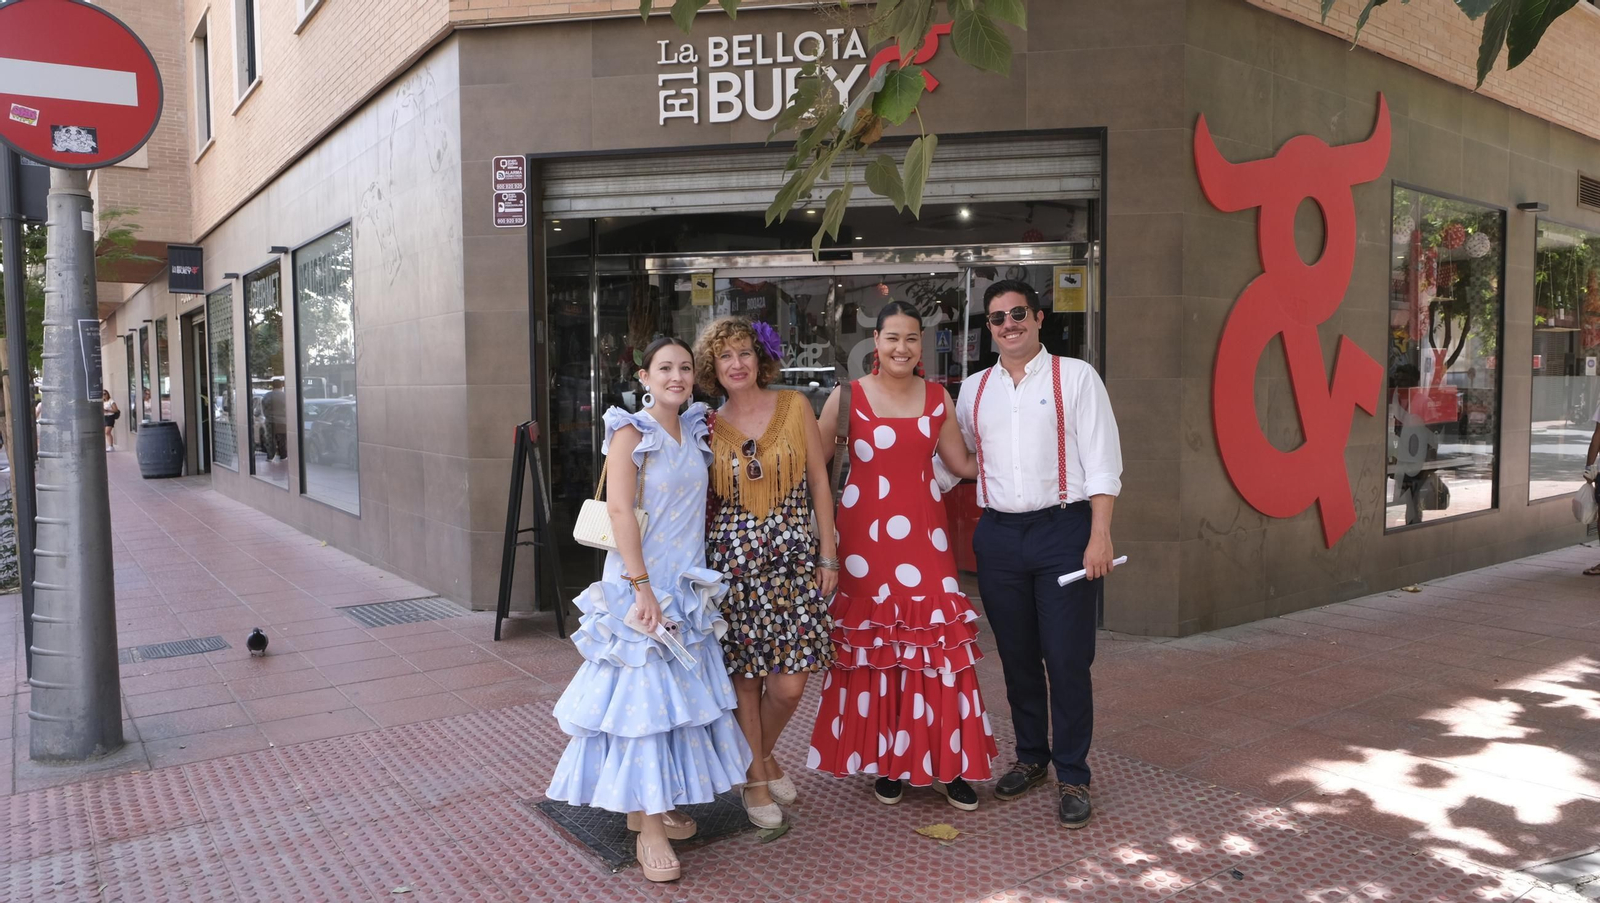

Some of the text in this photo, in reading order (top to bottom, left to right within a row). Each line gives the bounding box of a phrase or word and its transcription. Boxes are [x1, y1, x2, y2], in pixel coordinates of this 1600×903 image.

[657, 28, 867, 68] La BELLOTA
[657, 66, 700, 126] El
